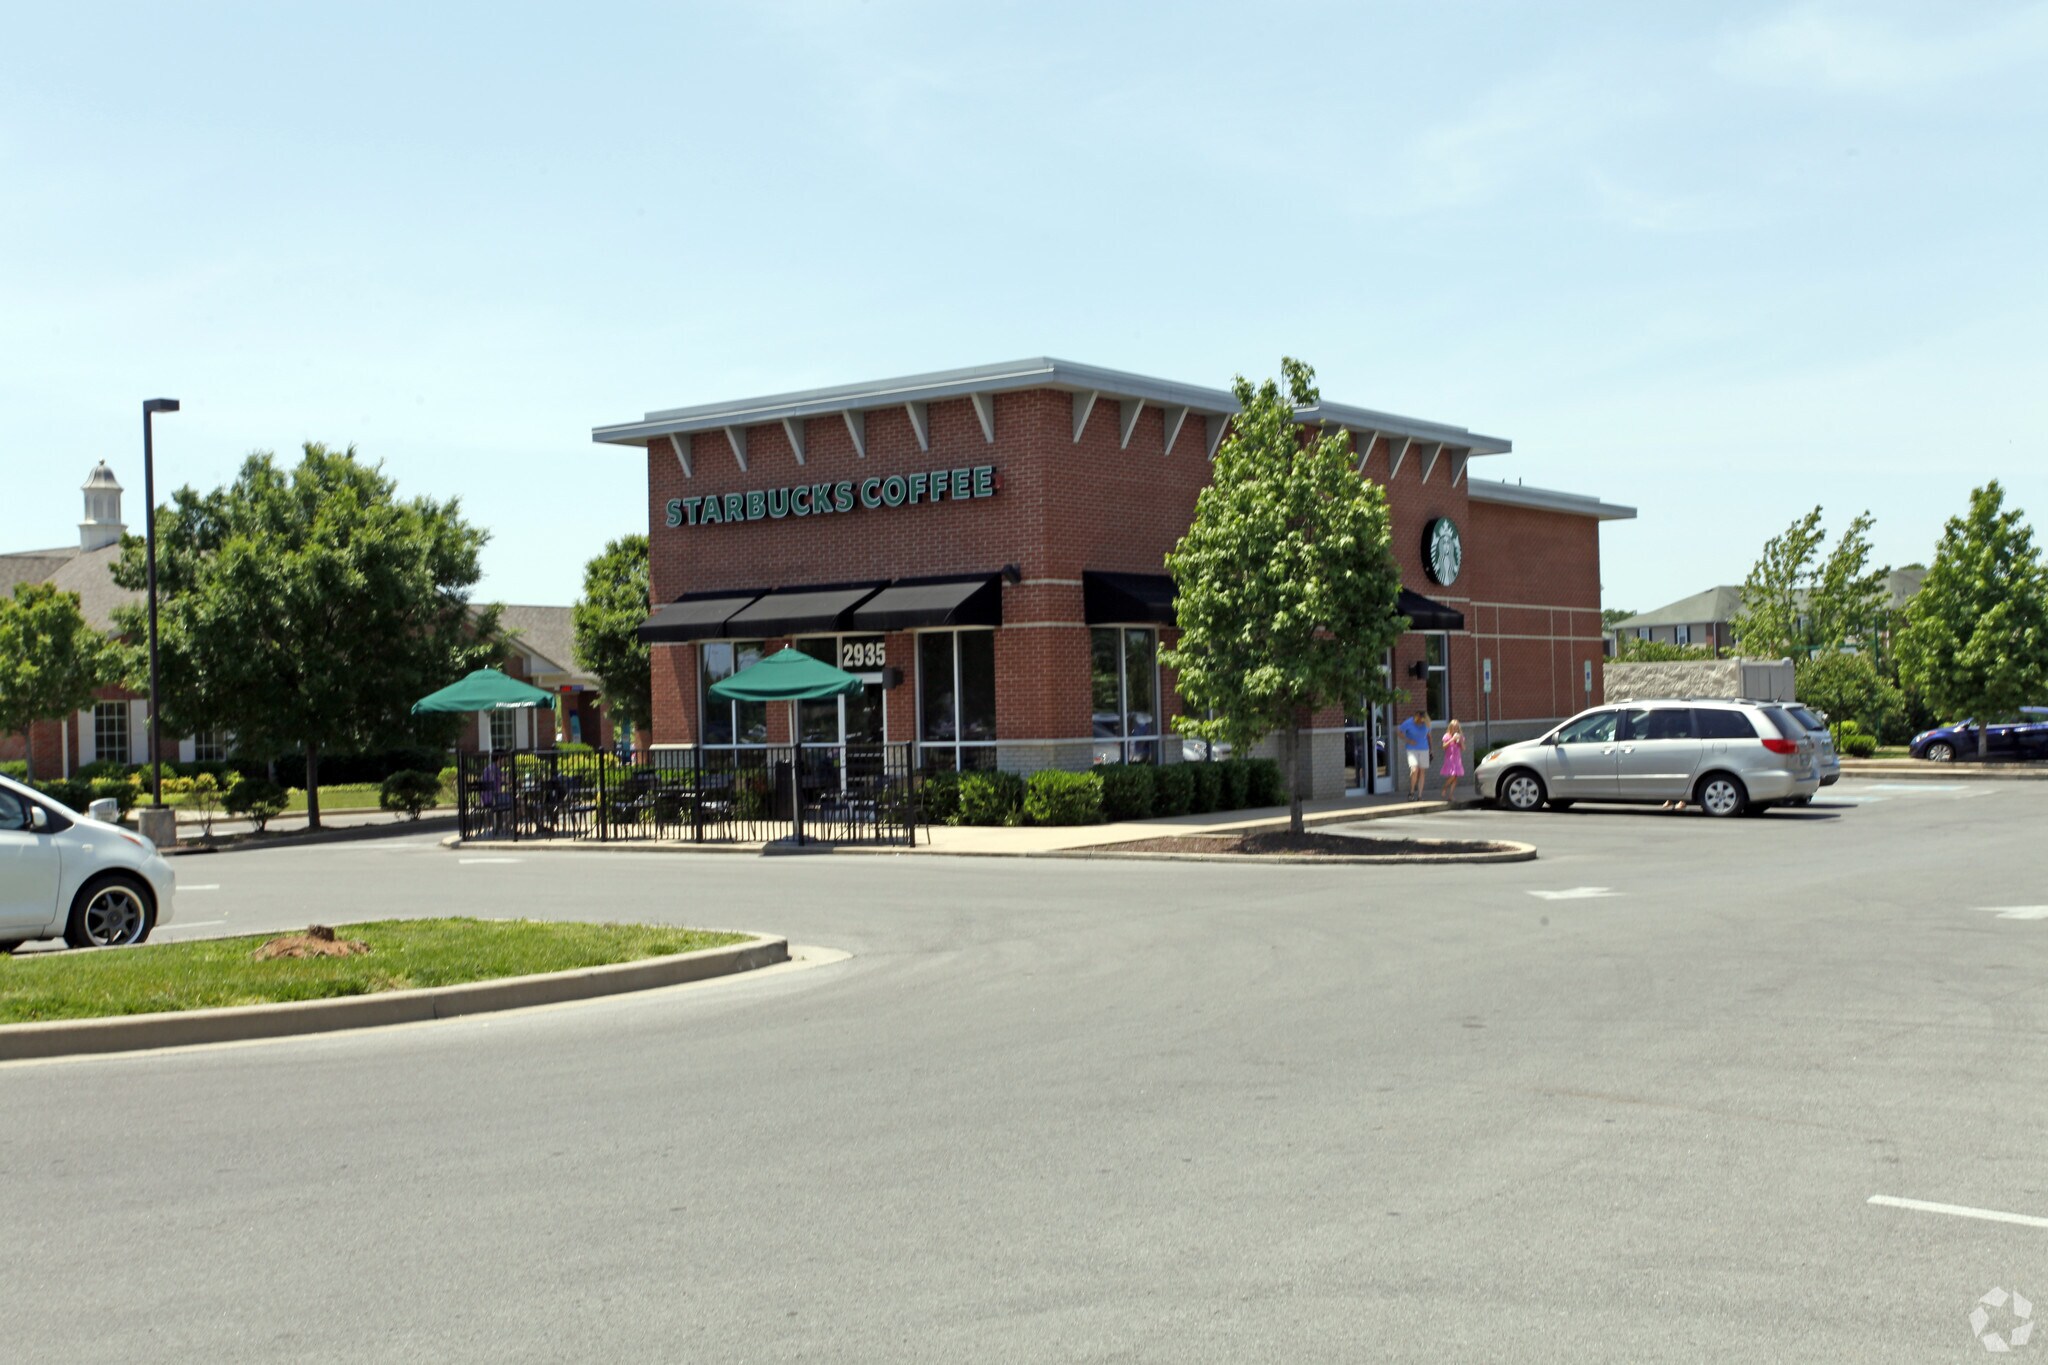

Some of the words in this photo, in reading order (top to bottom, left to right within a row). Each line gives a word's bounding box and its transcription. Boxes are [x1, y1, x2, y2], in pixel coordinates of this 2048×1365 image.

[665, 480, 854, 528] STARBUCKS
[860, 465, 994, 509] COFFEE
[843, 642, 886, 667] 2935
